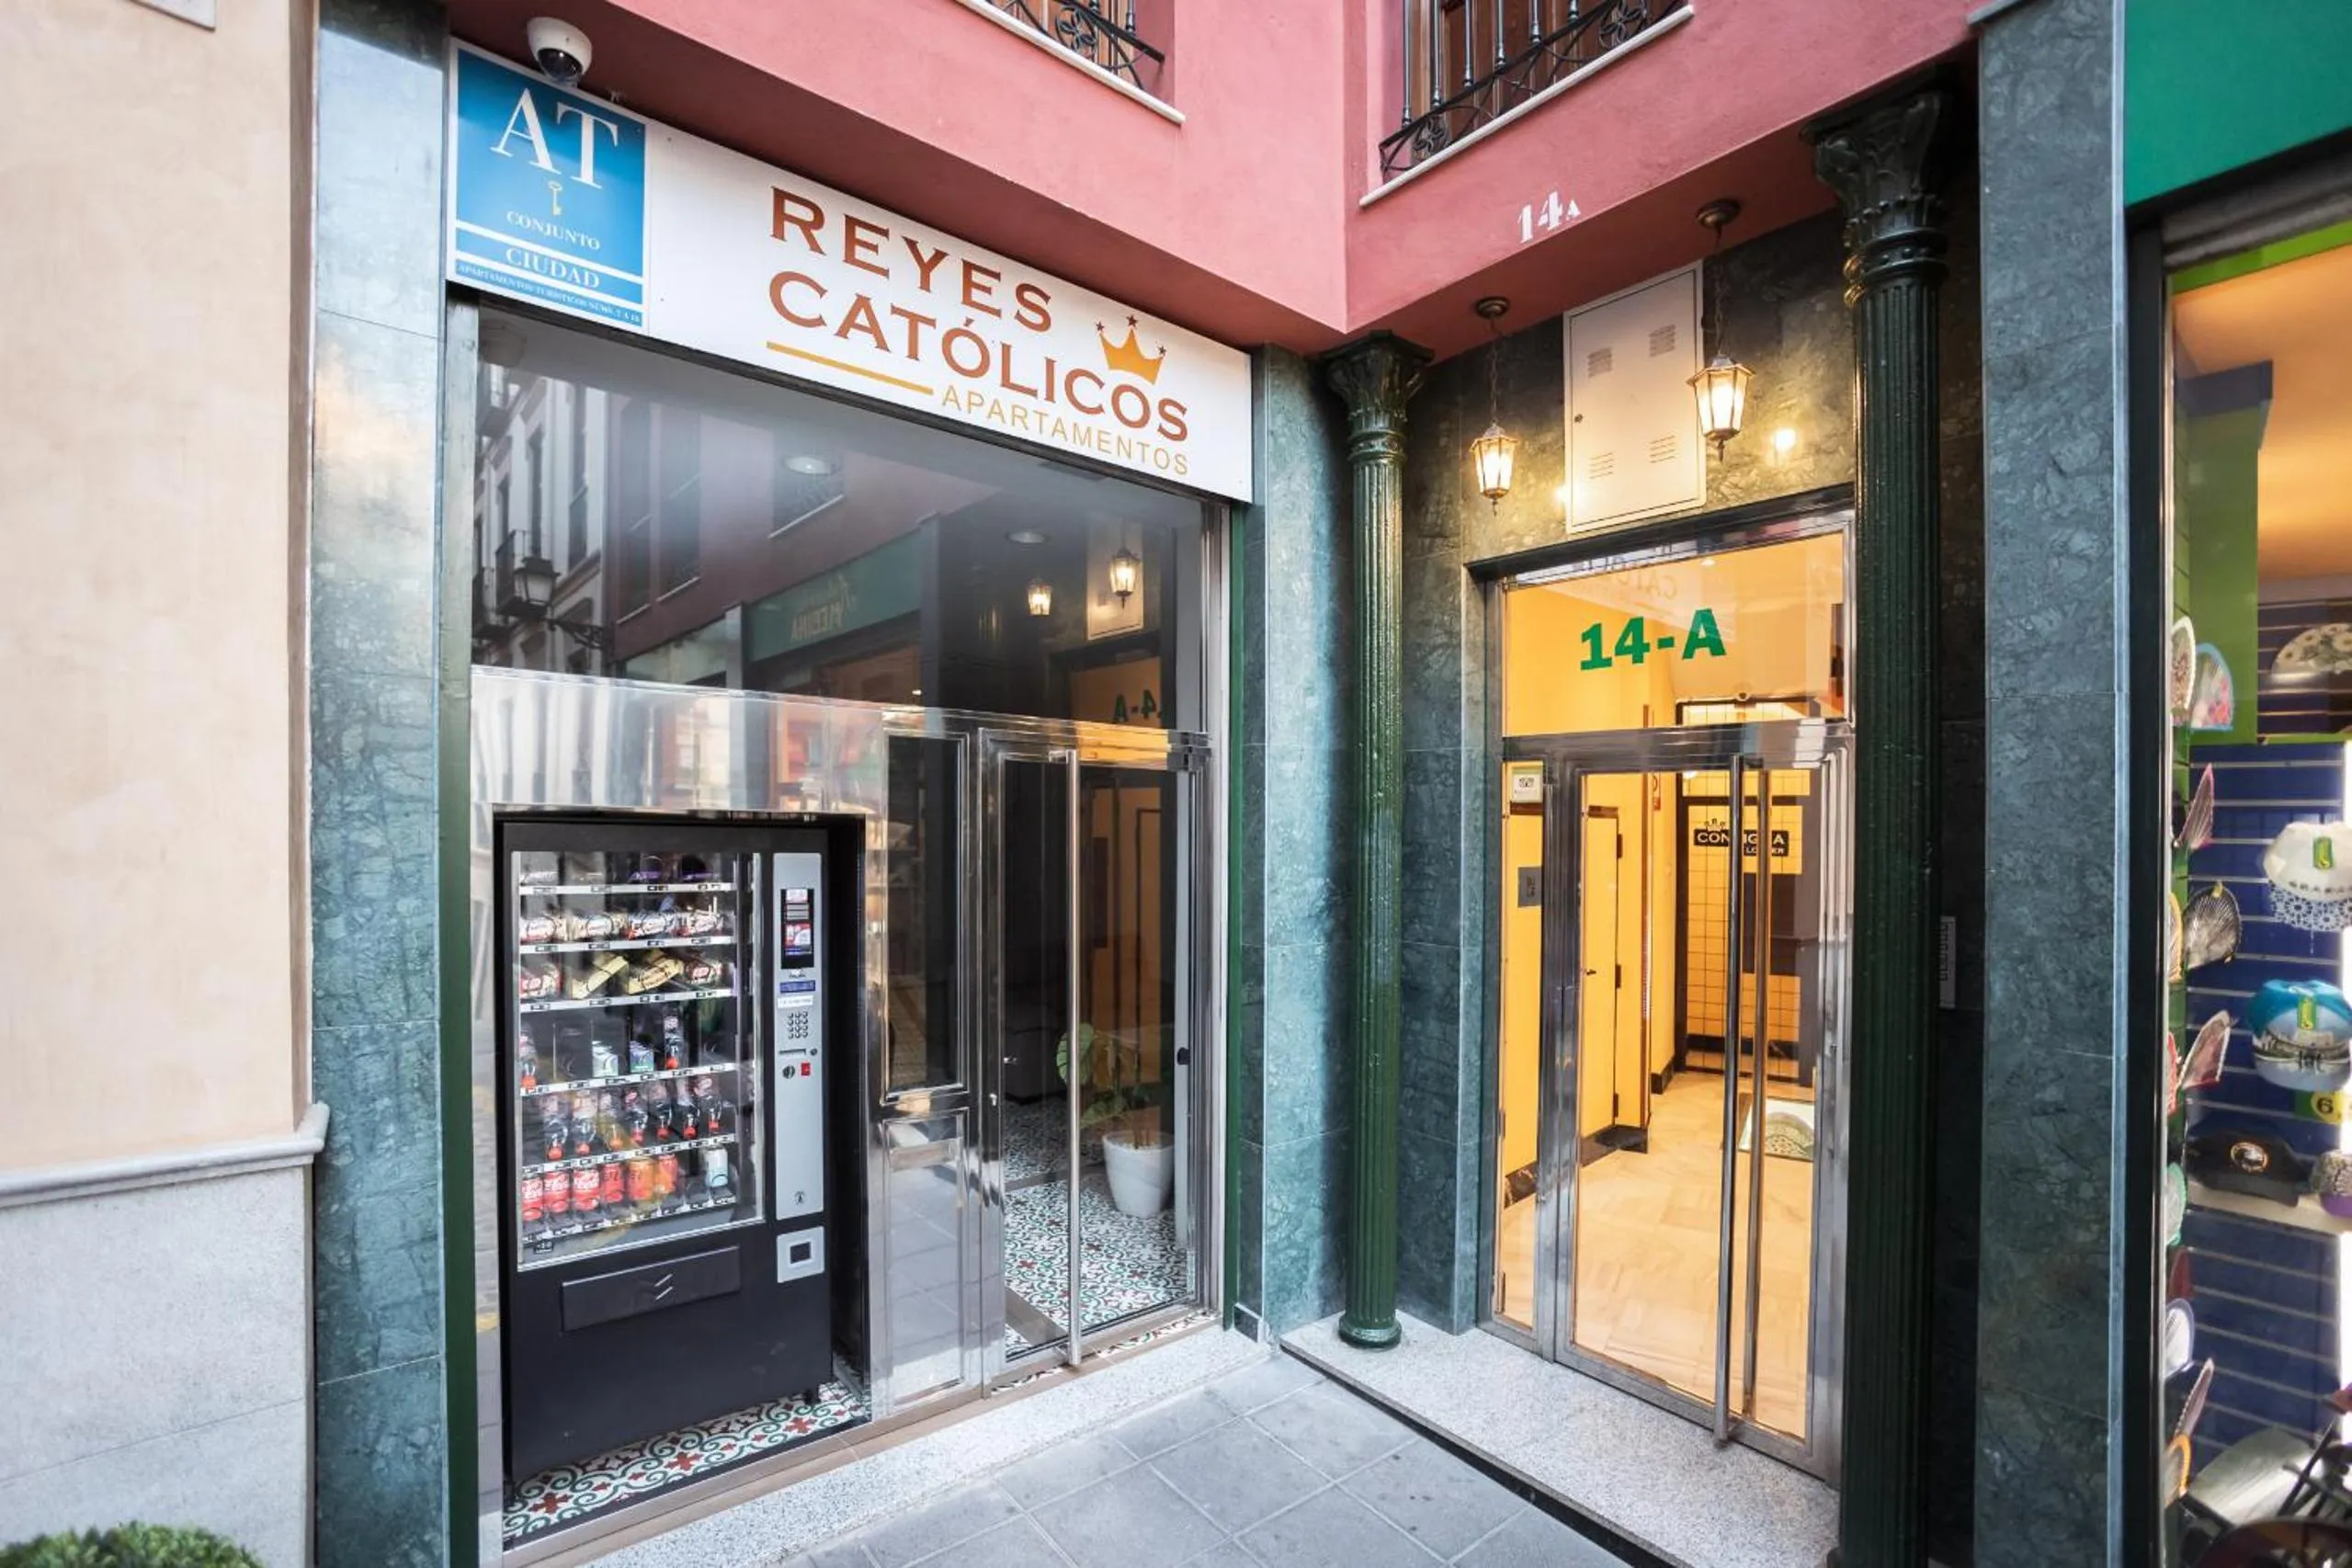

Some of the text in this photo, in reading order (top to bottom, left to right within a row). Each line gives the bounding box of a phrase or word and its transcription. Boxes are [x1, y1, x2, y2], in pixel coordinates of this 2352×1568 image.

[490, 87, 619, 188] AT
[506, 210, 600, 251] CONJUNTO
[506, 247, 600, 289] CIUDAD
[770, 186, 1051, 332] REYES
[768, 270, 1188, 442] CATÓLICOS
[942, 385, 1188, 475] APARTAMENTOS
[1580, 608, 1727, 670] 14-A
[1698, 832, 1786, 845] CONIGA
